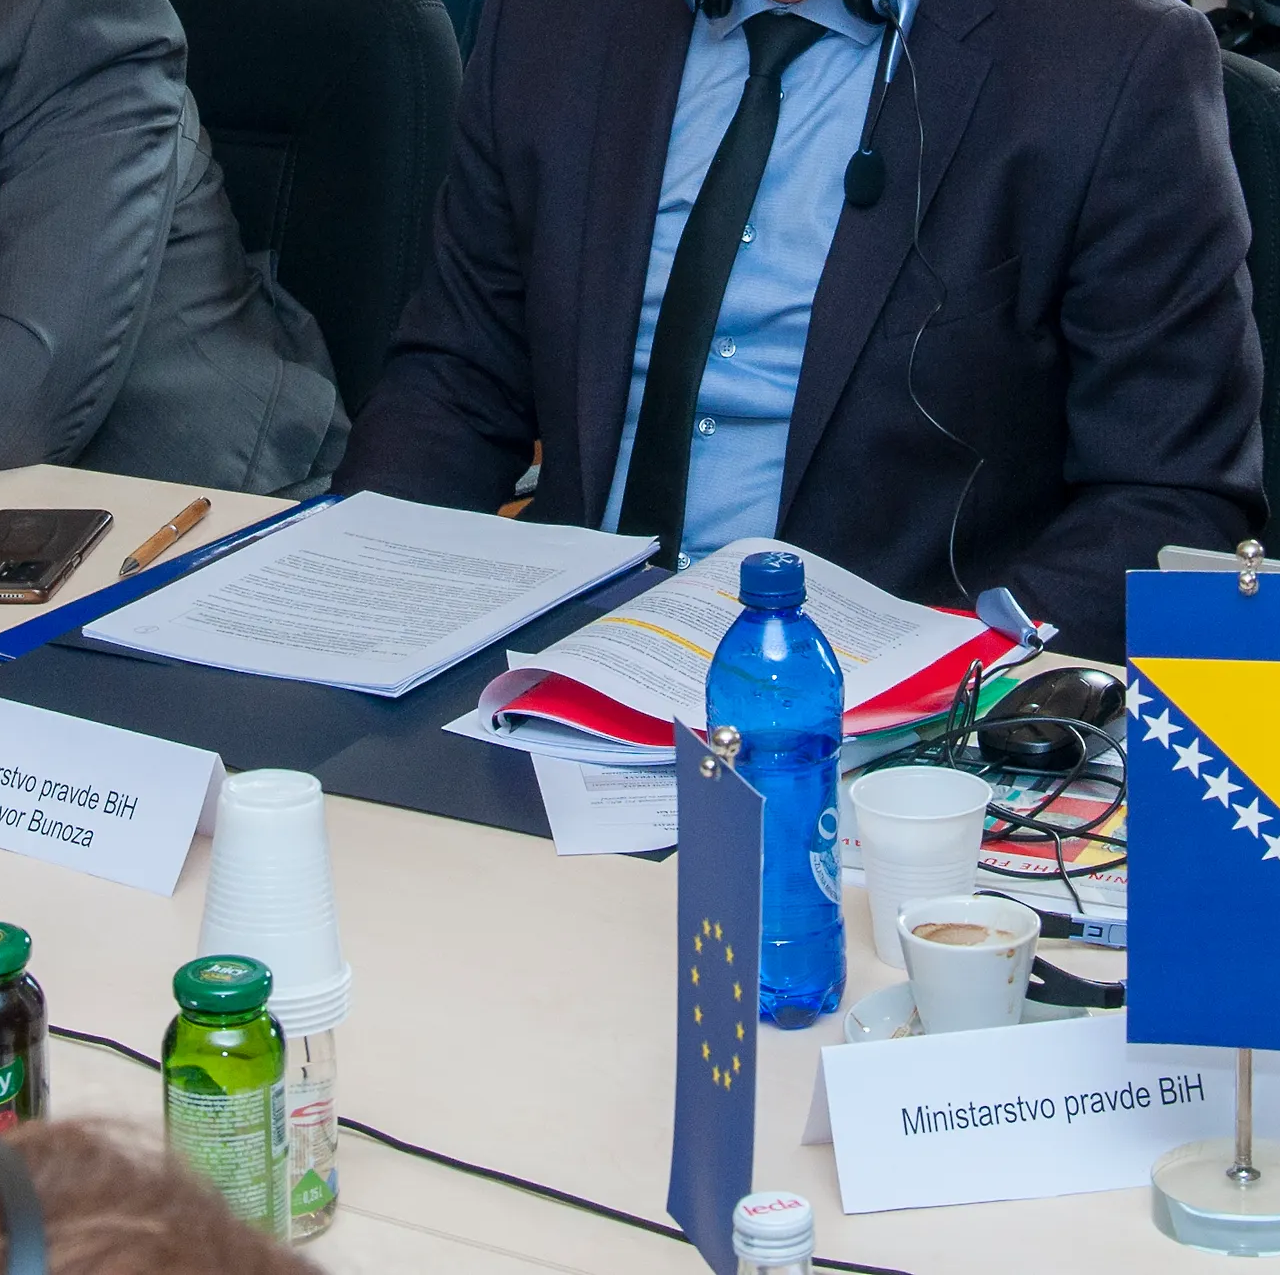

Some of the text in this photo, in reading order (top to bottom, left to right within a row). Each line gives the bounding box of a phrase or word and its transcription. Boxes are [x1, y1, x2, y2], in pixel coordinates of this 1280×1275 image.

[39, 778, 100, 811] pravde
[104, 790, 139, 820] BiH
[28, 809, 95, 848] Bunoza
[901, 1073, 1205, 1136] Ministarstvo pravde BiH
[742, 1199, 803, 1216] leda
